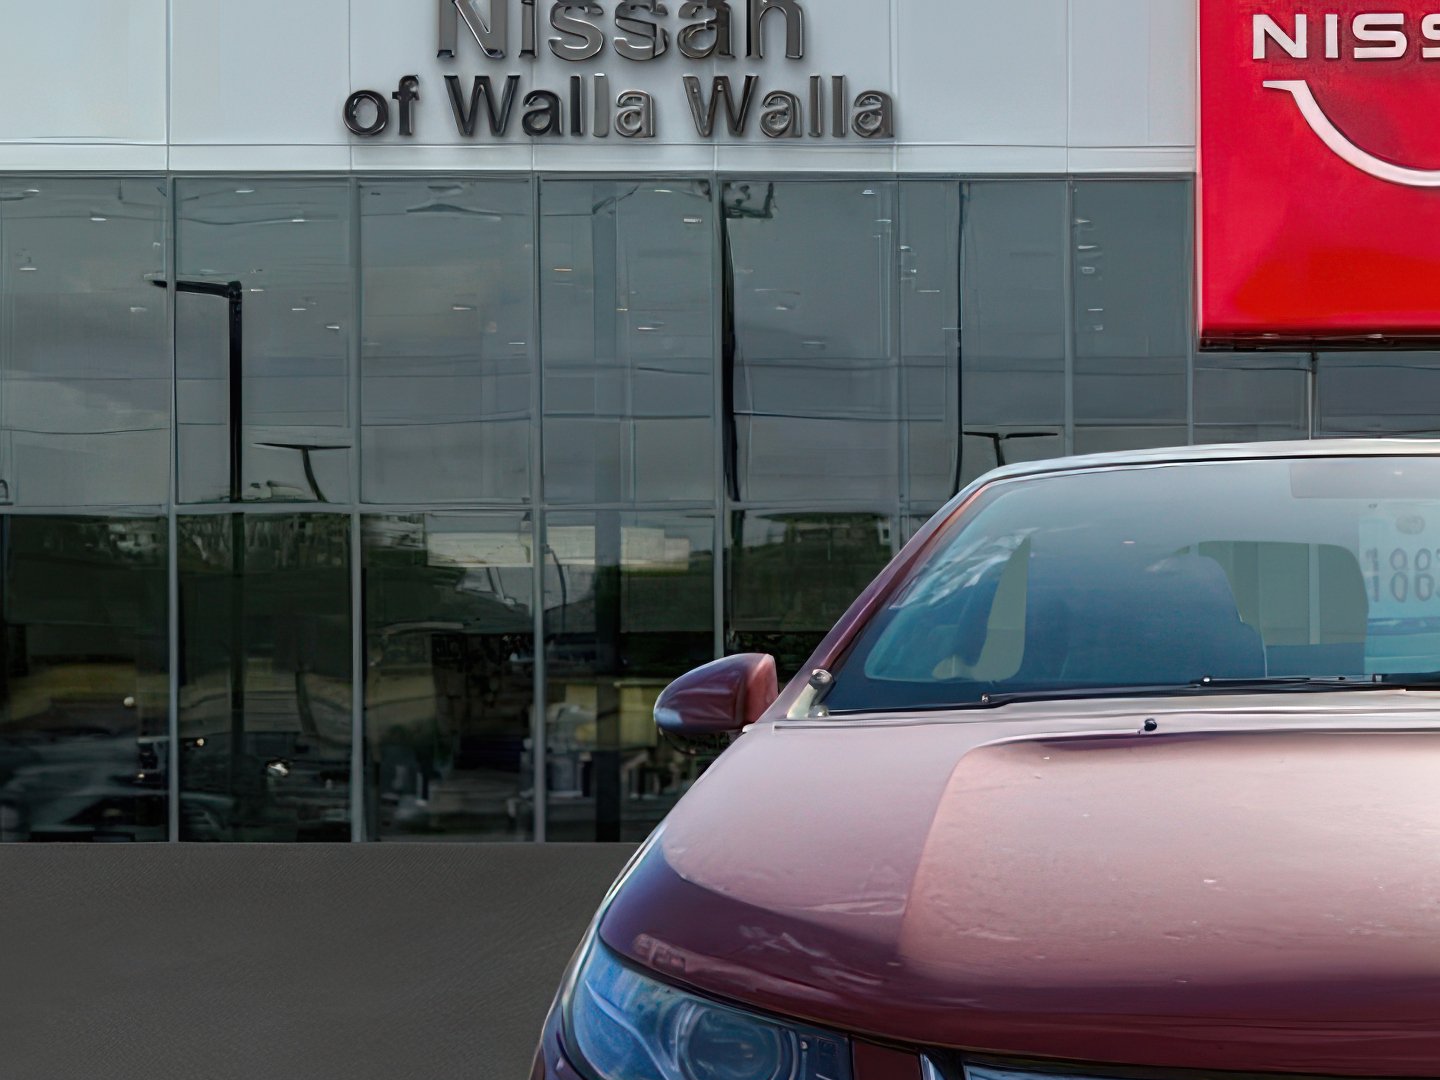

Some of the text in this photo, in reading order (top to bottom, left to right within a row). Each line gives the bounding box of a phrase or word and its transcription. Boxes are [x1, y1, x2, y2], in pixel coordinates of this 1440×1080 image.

[342, 74, 895, 138] of Walla Walla
